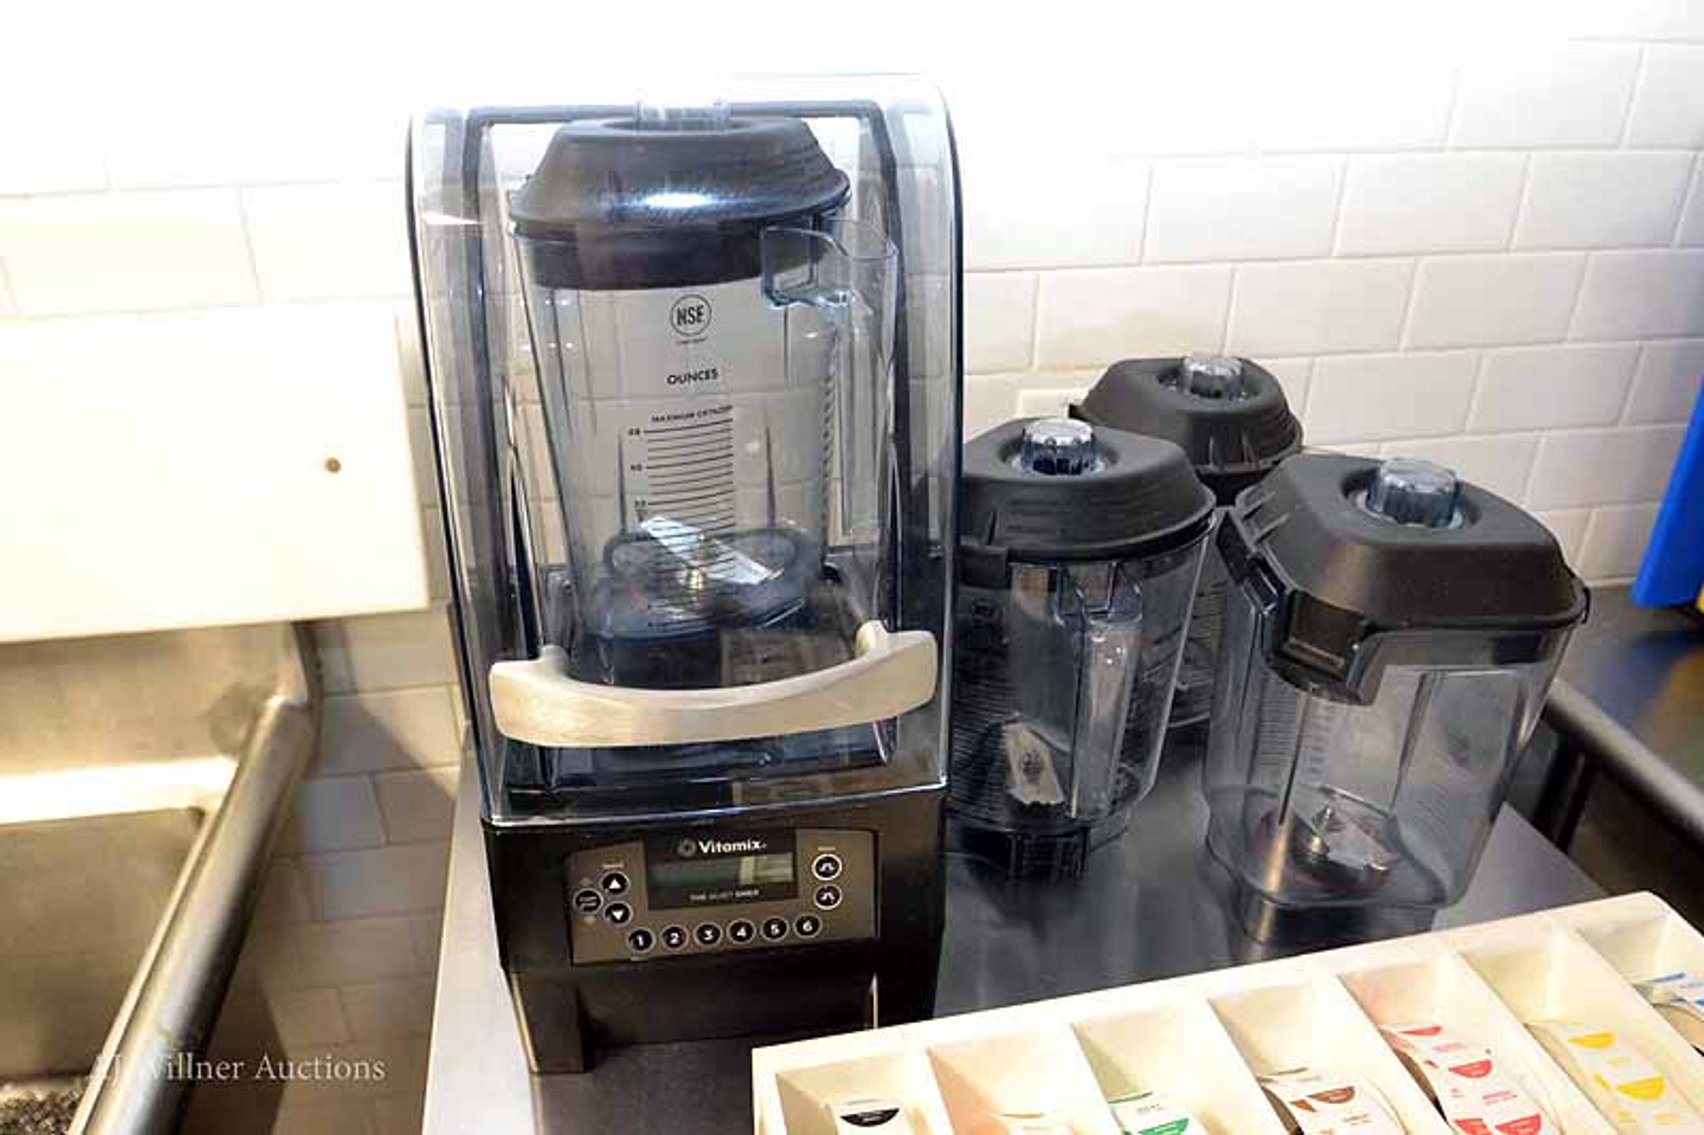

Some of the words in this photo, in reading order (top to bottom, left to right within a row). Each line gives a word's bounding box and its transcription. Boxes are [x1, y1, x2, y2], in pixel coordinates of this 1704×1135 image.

[667, 368, 719, 385] OUNCES
[699, 839, 762, 853] Vitamix
[637, 935, 645, 946] 1
[670, 932, 679, 944] 2
[704, 929, 713, 941] 3
[736, 926, 747, 938] 4
[770, 923, 780, 935] 5
[802, 920, 813, 932] 6
